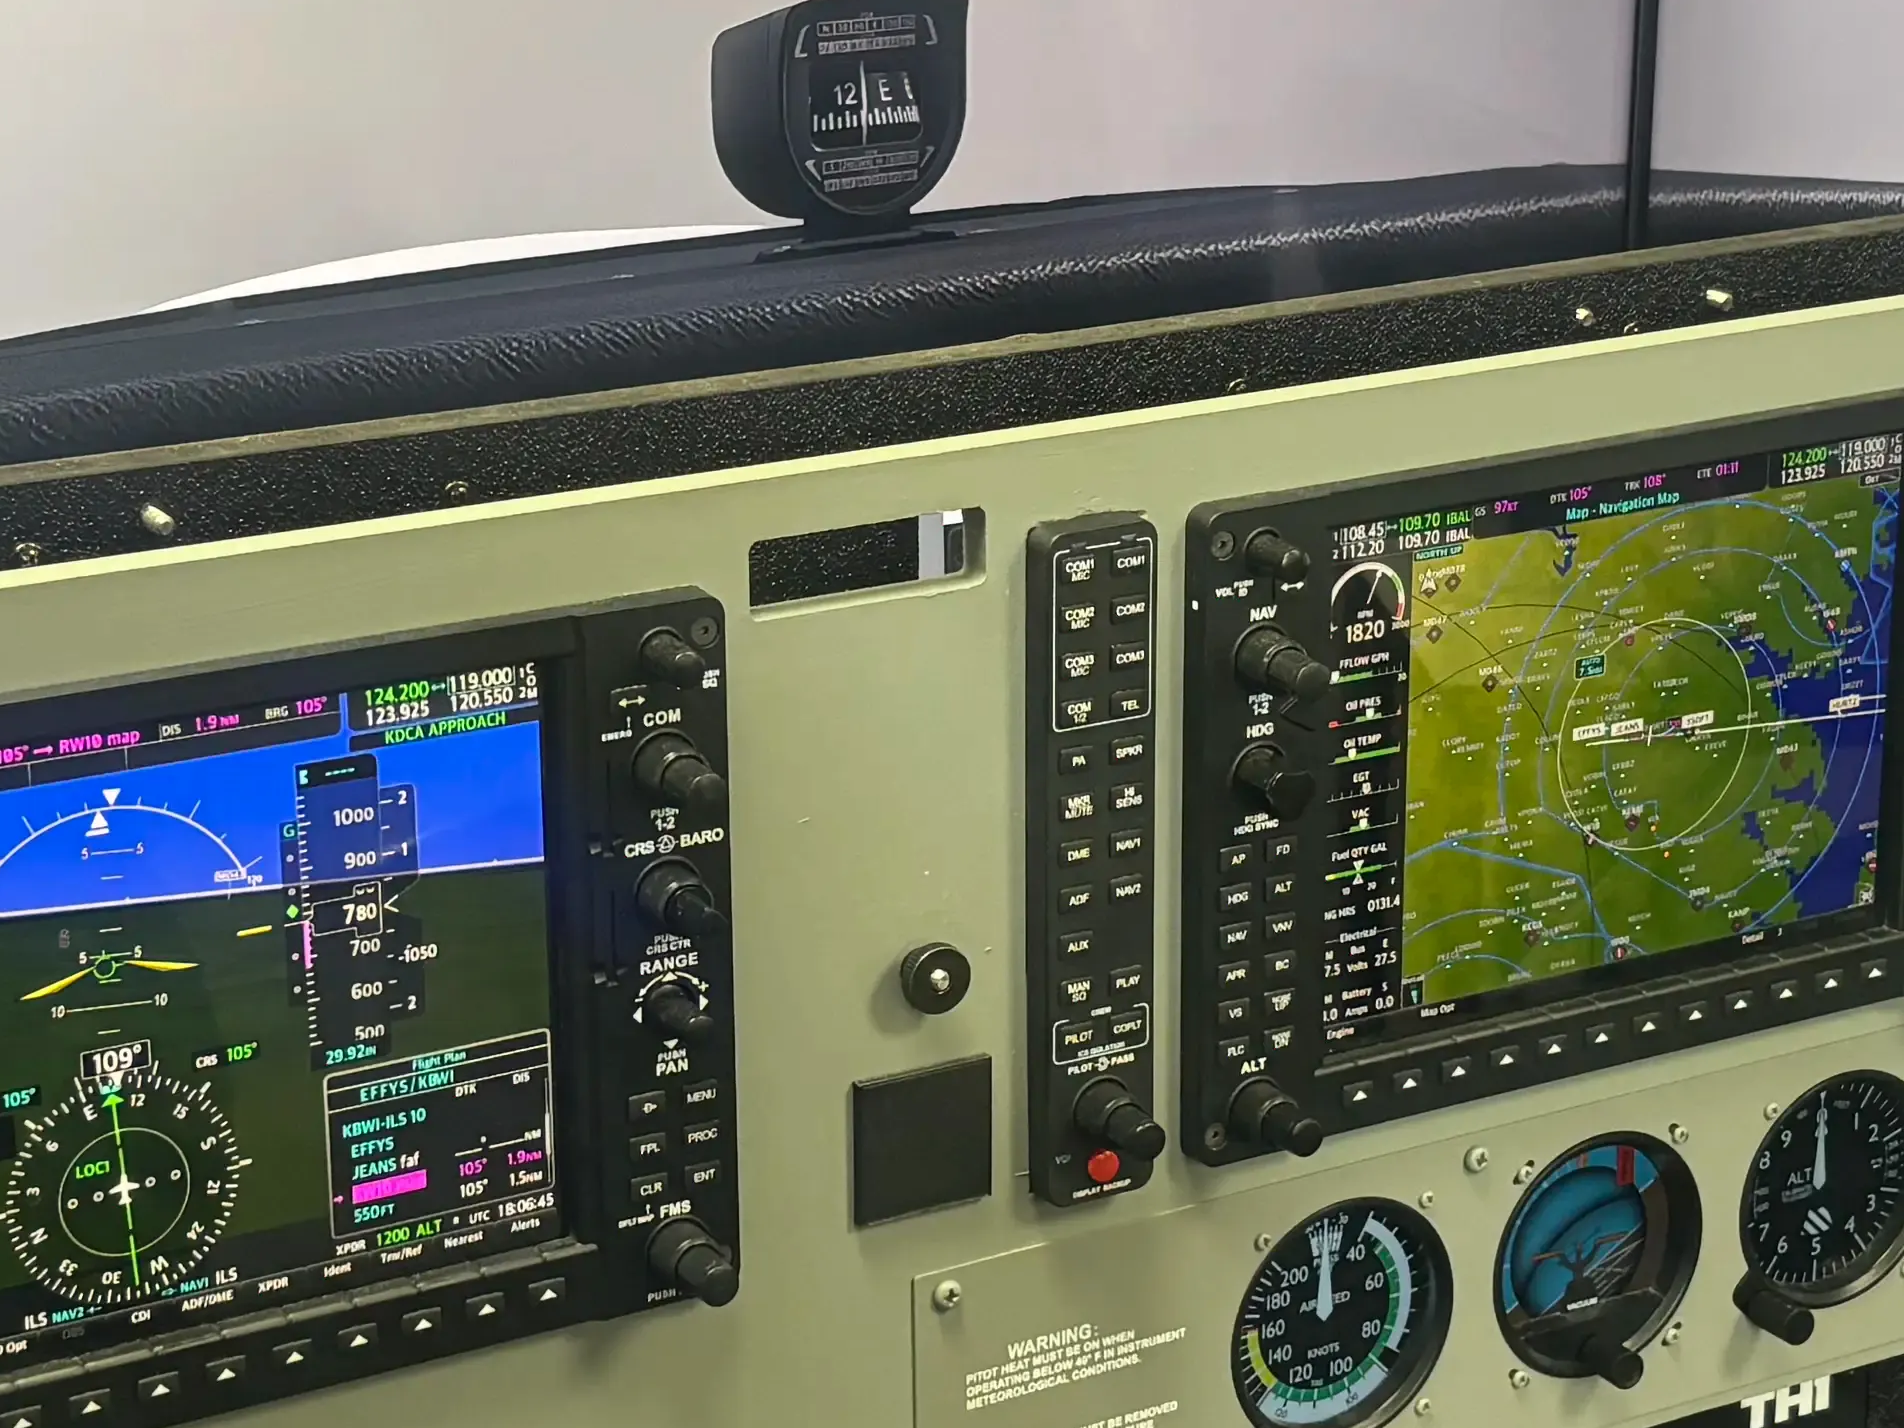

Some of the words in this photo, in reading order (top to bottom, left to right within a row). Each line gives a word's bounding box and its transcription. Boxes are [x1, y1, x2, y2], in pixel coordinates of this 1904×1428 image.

[834, 82, 858, 106] 12
[878, 79, 893, 102] E
[1781, 447, 1827, 467] 124.200
[1781, 465, 1825, 484] 123.925
[1840, 454, 1884, 473] 120.550
[1342, 523, 1384, 540] 108.45
[1398, 513, 1440, 532] 109.70
[1446, 510, 1471, 525] IBAL
[1341, 540, 1384, 560] 112.20
[1398, 531, 1441, 550] 109.70
[1446, 528, 1471, 543] IBAL
[1117, 554, 1145, 569] COM1
[1116, 602, 1145, 617] COM2
[1249, 606, 1277, 621] NAV
[1345, 621, 1384, 645] 1820
[365, 681, 429, 705] 124.200
[450, 668, 512, 691] 119.000
[367, 701, 429, 725] 123.925
[451, 688, 513, 712] 120.550
[385, 725, 424, 744] KDCA
[428, 711, 506, 738] APPROACH
[643, 708, 681, 728] COM
[1246, 722, 1273, 738] HDG
[333, 806, 374, 827] 1000
[1352, 808, 1369, 819] VAC
[344, 850, 376, 870] 900
[1068, 893, 1090, 906] ADF
[1115, 884, 1141, 897] NAV2
[343, 901, 377, 925] 780
[350, 938, 380, 956] 700
[1067, 940, 1088, 953] AUX
[640, 952, 698, 975] RANGE
[351, 981, 382, 999] 600
[1068, 981, 1090, 995] MAN
[1116, 974, 1140, 989] PLAY
[1342, 985, 1372, 1000] Battery
[1326, 1025, 1354, 1040] Engine
[93, 1044, 142, 1074] 109°
[196, 1055, 217, 1069] CRS
[226, 1042, 257, 1062] 105°
[655, 1058, 688, 1077] PAN
[1240, 1058, 1267, 1074] ALT
[3, 1088, 35, 1108] 105°
[455, 1084, 477, 1098] DTK
[351, 1137, 394, 1159] EFFYS
[1346, 1243, 1365, 1261] 40
[258, 1276, 289, 1293] XPDR
[1280, 1266, 1309, 1288] 200
[1364, 1272, 1384, 1291] 60
[182, 1290, 234, 1311] ADF/DME
[1266, 1290, 1291, 1311] 180
[25, 1313, 47, 1330] ILS
[52, 1306, 84, 1324] NAV2
[1262, 1319, 1286, 1339] 160
[1361, 1319, 1381, 1339] 80
[1008, 1324, 1098, 1360] WARNING:
[1307, 1342, 1340, 1359] KNOTS
[966, 1369, 998, 1385] PITOT
[1001, 1359, 1030, 1377] HEAT
[1033, 1348, 1063, 1366] MUST
[1066, 1345, 1080, 1357] BE
[1084, 1339, 1100, 1352] ON
[1102, 1330, 1135, 1347] WHEN
[967, 1370, 1030, 1397] OPERATING
[1033, 1360, 1072, 1379] BELOW
[1075, 1354, 1091, 1366] 40°
[1095, 1351, 1102, 1362] F
[1104, 1348, 1115, 1359] IN
[1117, 1328, 1186, 1356] INSTRUMENT
[1268, 1344, 1293, 1365] 140
[1289, 1364, 1313, 1384] 120
[1329, 1356, 1353, 1377] 100
[967, 1375, 1070, 1410] METEOROLOGICAL
[1072, 1354, 1142, 1381] CONDITIONS.
